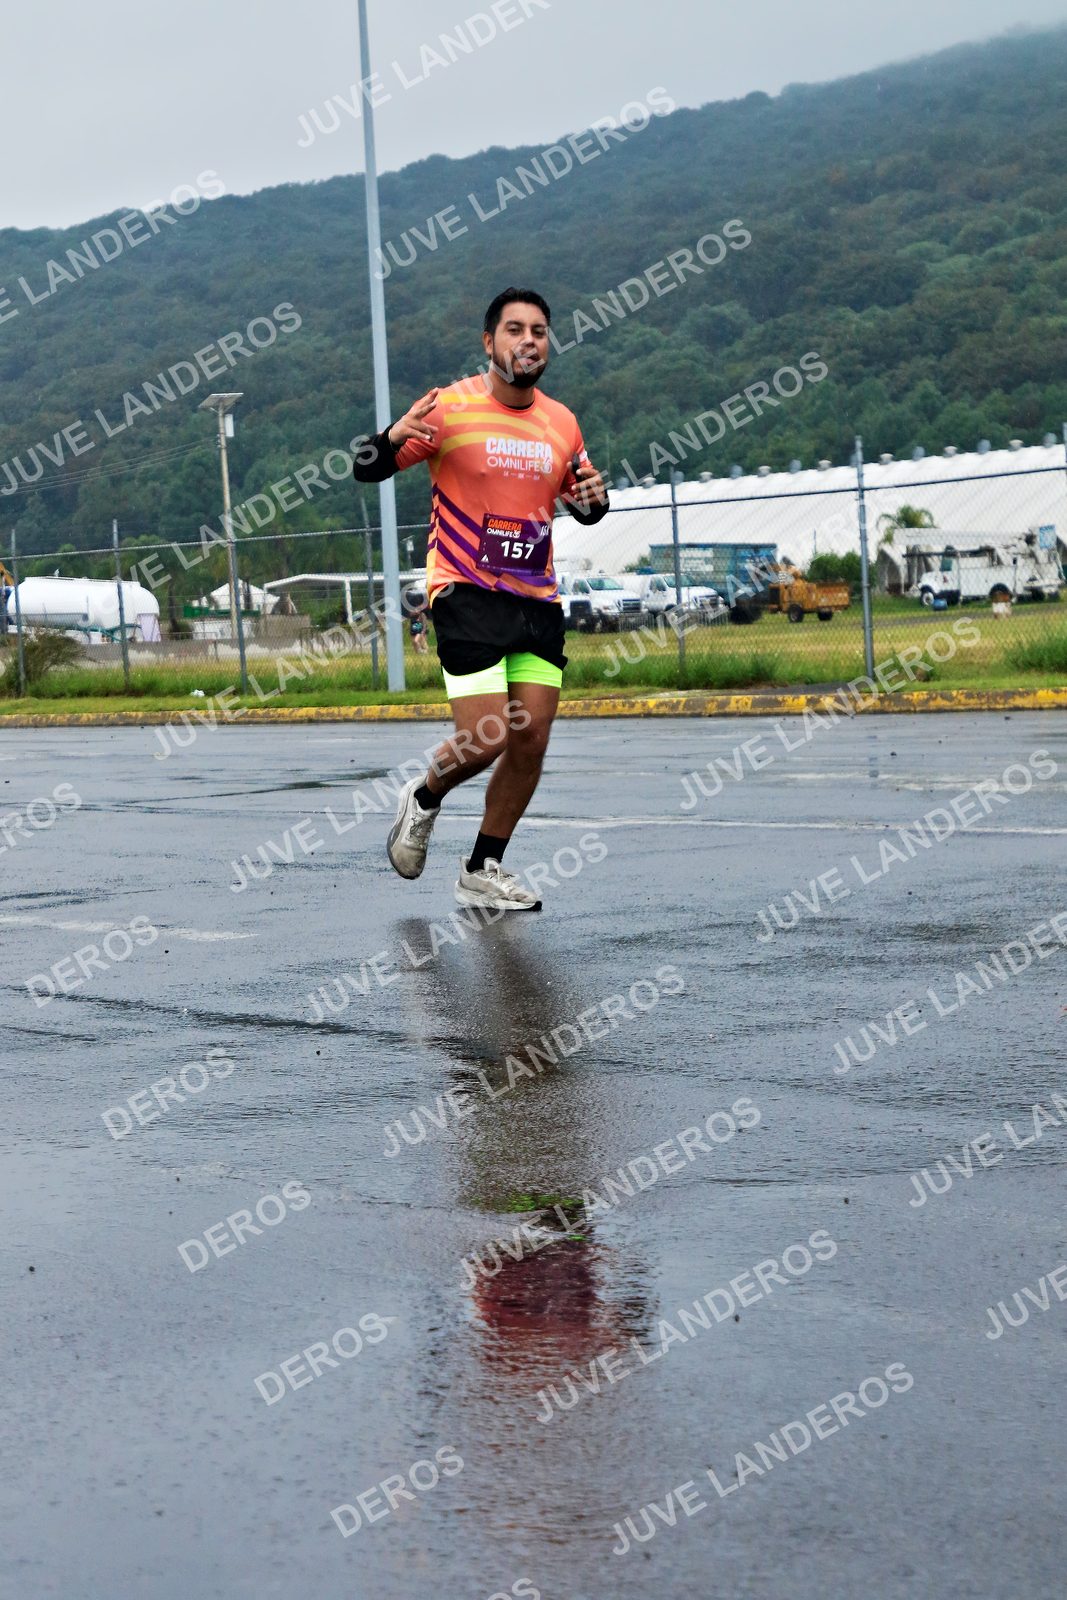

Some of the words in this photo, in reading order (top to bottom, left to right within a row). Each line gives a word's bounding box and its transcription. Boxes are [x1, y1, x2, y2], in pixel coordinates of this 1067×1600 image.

[486, 437, 553, 464] CARRERA
[487, 456, 540, 472] OMNILIFE
[488, 519, 522, 531] CARRERA
[501, 541, 534, 560] 157
